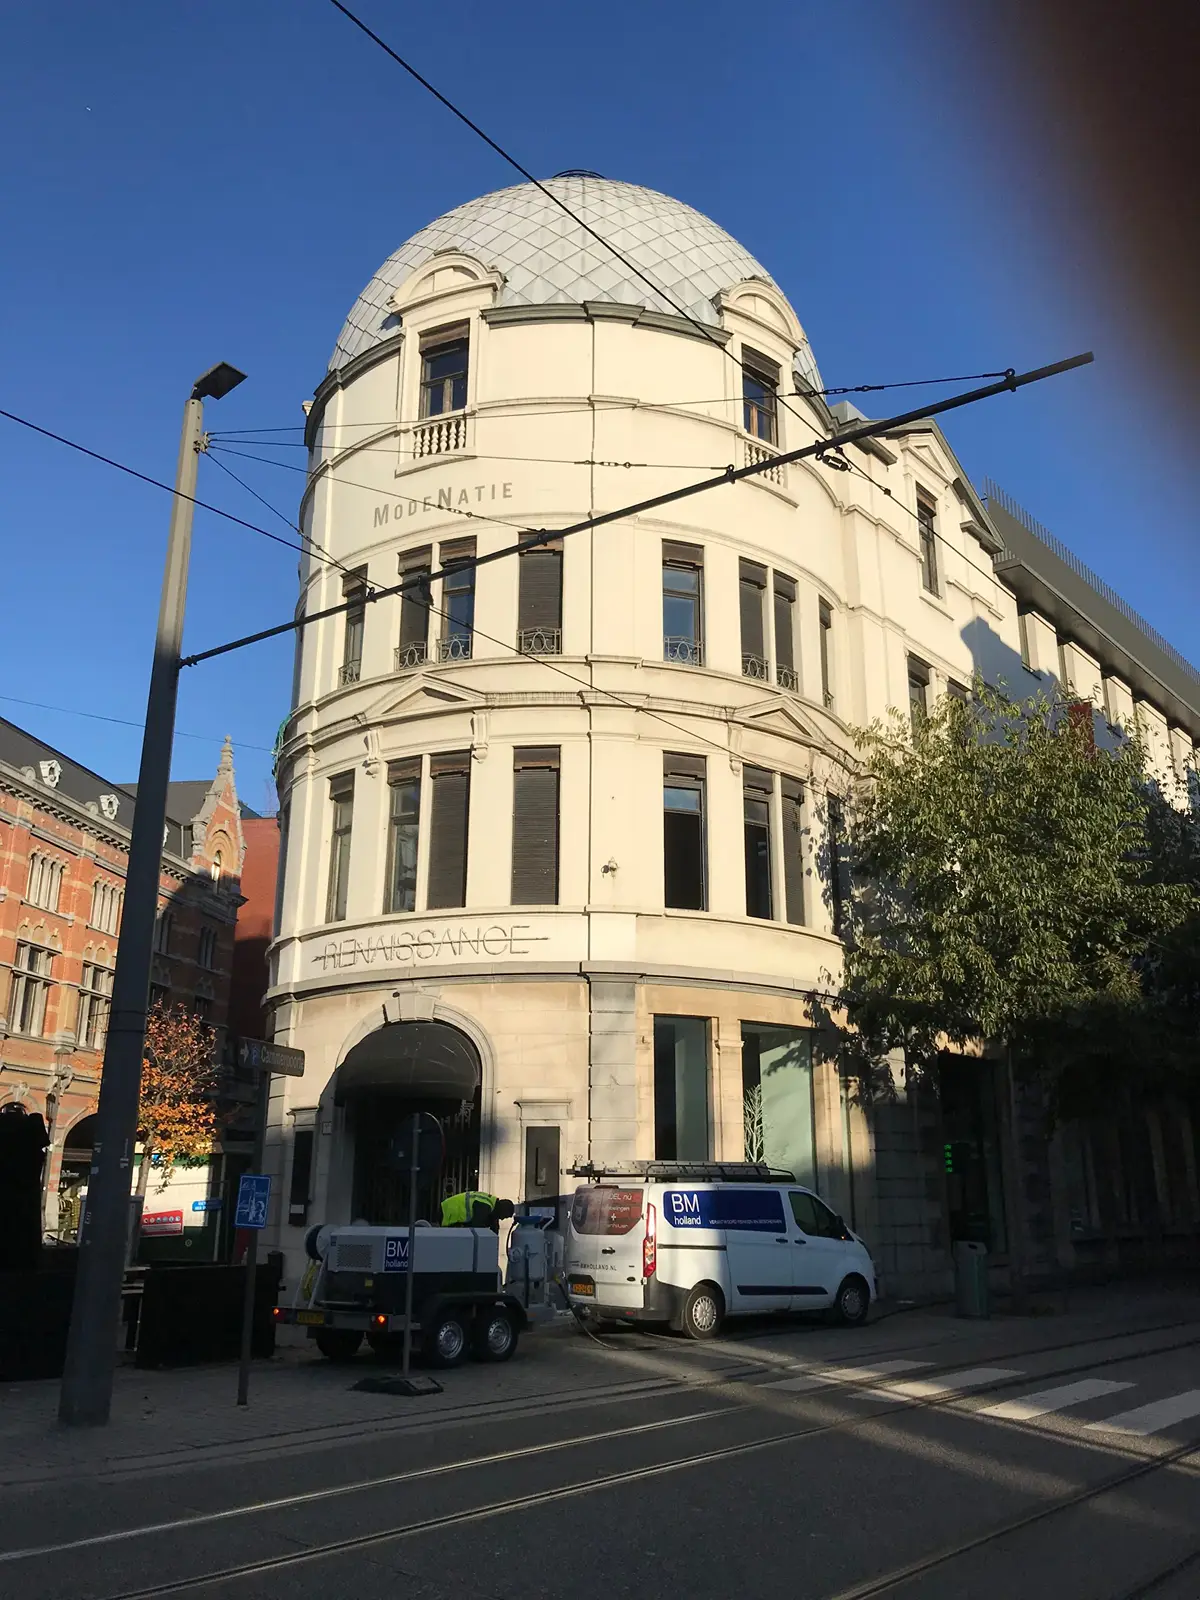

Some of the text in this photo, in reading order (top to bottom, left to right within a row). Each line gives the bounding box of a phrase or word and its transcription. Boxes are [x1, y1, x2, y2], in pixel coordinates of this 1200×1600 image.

[322, 925, 531, 970] RENAISSANCE
[671, 1193, 700, 1213] BM
[674, 1215, 702, 1226] holland
[386, 1240, 409, 1257] BM
